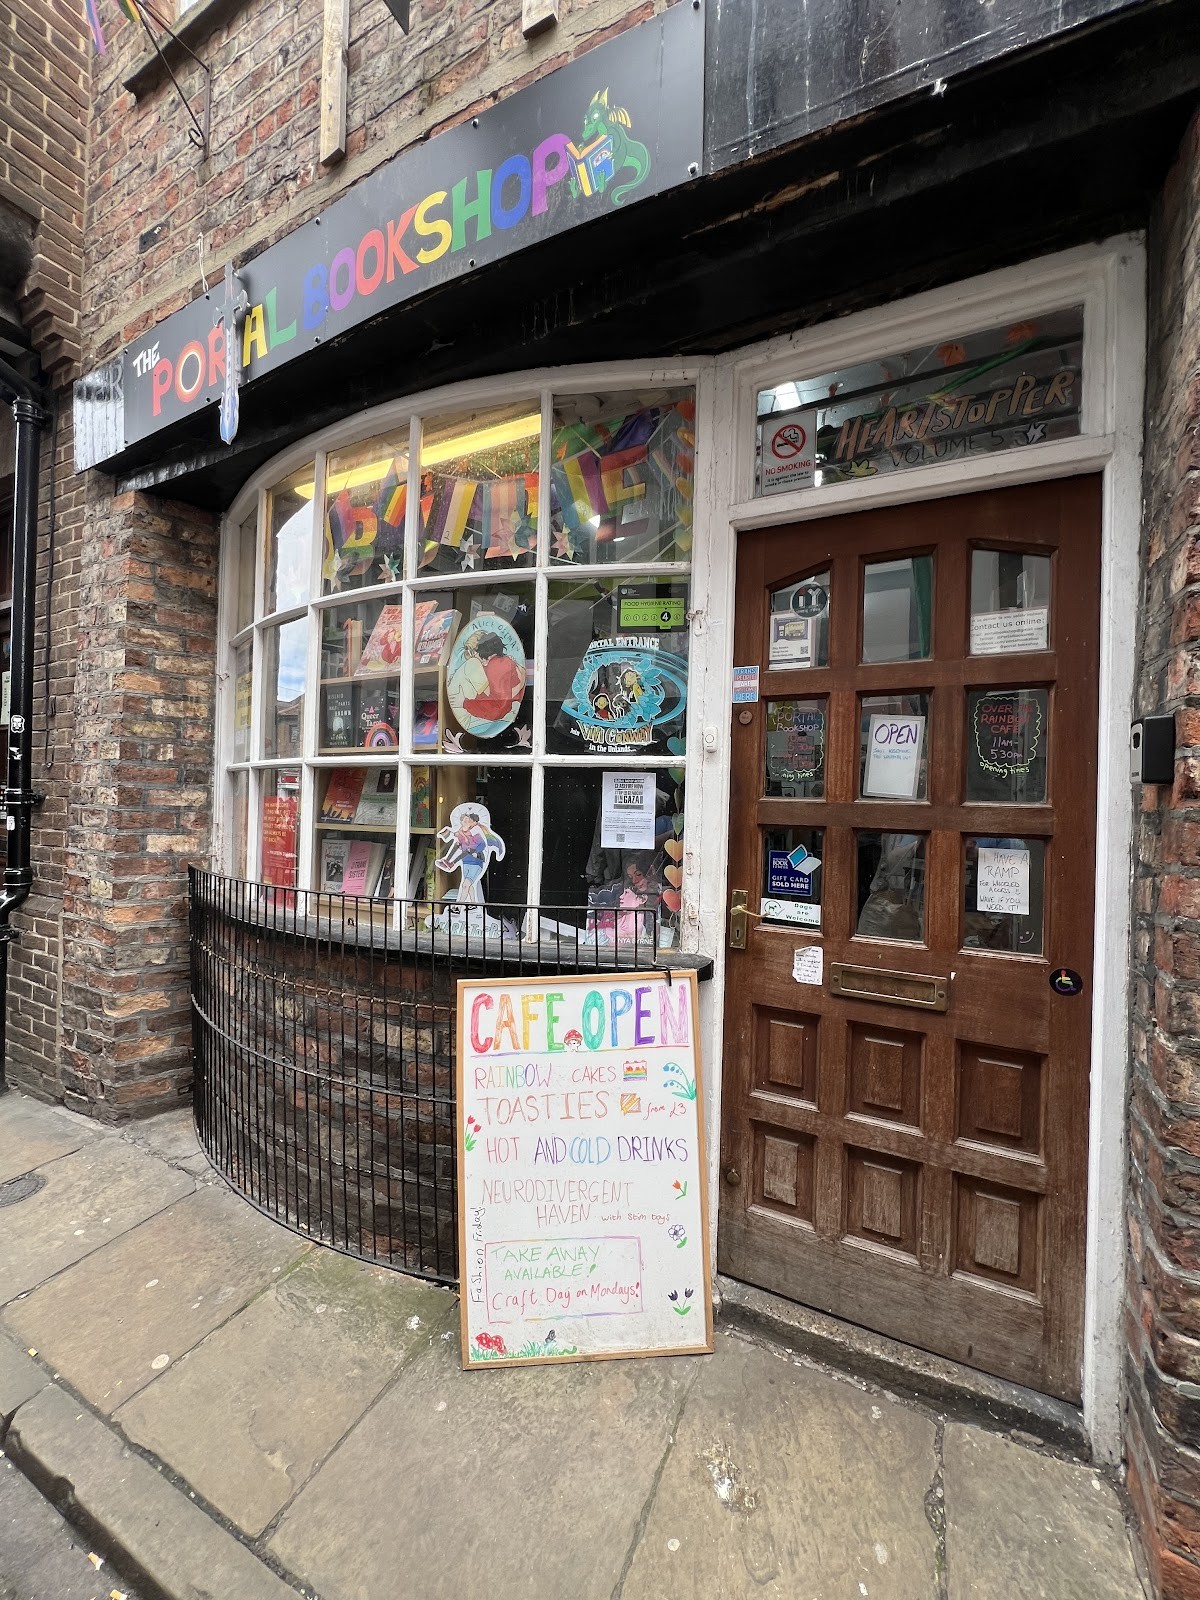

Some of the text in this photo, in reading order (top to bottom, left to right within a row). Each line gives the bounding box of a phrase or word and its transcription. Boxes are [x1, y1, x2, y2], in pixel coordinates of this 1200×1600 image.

[132, 341, 160, 377] THE
[301, 132, 572, 331] BOOKSHOP
[891, 434, 980, 467] VOLUME
[765, 459, 811, 476] NO SMOKING
[661, 612, 669, 621] 4
[970, 622, 1000, 632] Contact
[1015, 618, 1045, 627] online:
[472, 620, 519, 652] ALICE OSEMAN
[615, 636, 660, 651] ENTRANCE
[735, 692, 756, 701] HERE
[361, 712, 380, 721] Queer
[981, 703, 1014, 713] OVER
[980, 713, 1031, 725] RAINBOW
[604, 720, 656, 746] CONWAY
[874, 723, 918, 745] OPEN
[597, 745, 607, 753] the
[979, 761, 1030, 779] opening times
[623, 795, 640, 804] GAZA
[993, 851, 1016, 865] HAVE
[1019, 852, 1029, 865] A
[789, 876, 810, 884] CARD
[984, 865, 1020, 878] RAMP
[771, 880, 790, 888] SOLD
[790, 882, 809, 890] HERE
[794, 903, 813, 911] Dogs
[785, 914, 820, 924] Welcome
[470, 984, 689, 1053] CAFE OPEN
[474, 1063, 617, 1090] RAINBOW CAKES
[477, 1090, 609, 1126] TOASTIES
[643, 1101, 666, 1121] from
[486, 1135, 689, 1165] HOT AND COLD DRINKS
[481, 1178, 634, 1206] NEURODIVERGENT
[536, 1203, 592, 1228] HAVEN
[601, 1213, 622, 1222] with
[651, 1213, 670, 1225] toys
[471, 1206, 486, 1303] Fashion Friday!
[490, 1245, 600, 1264] TAKE AWAY
[492, 1281, 641, 1316] Craft Day on Mondays!
